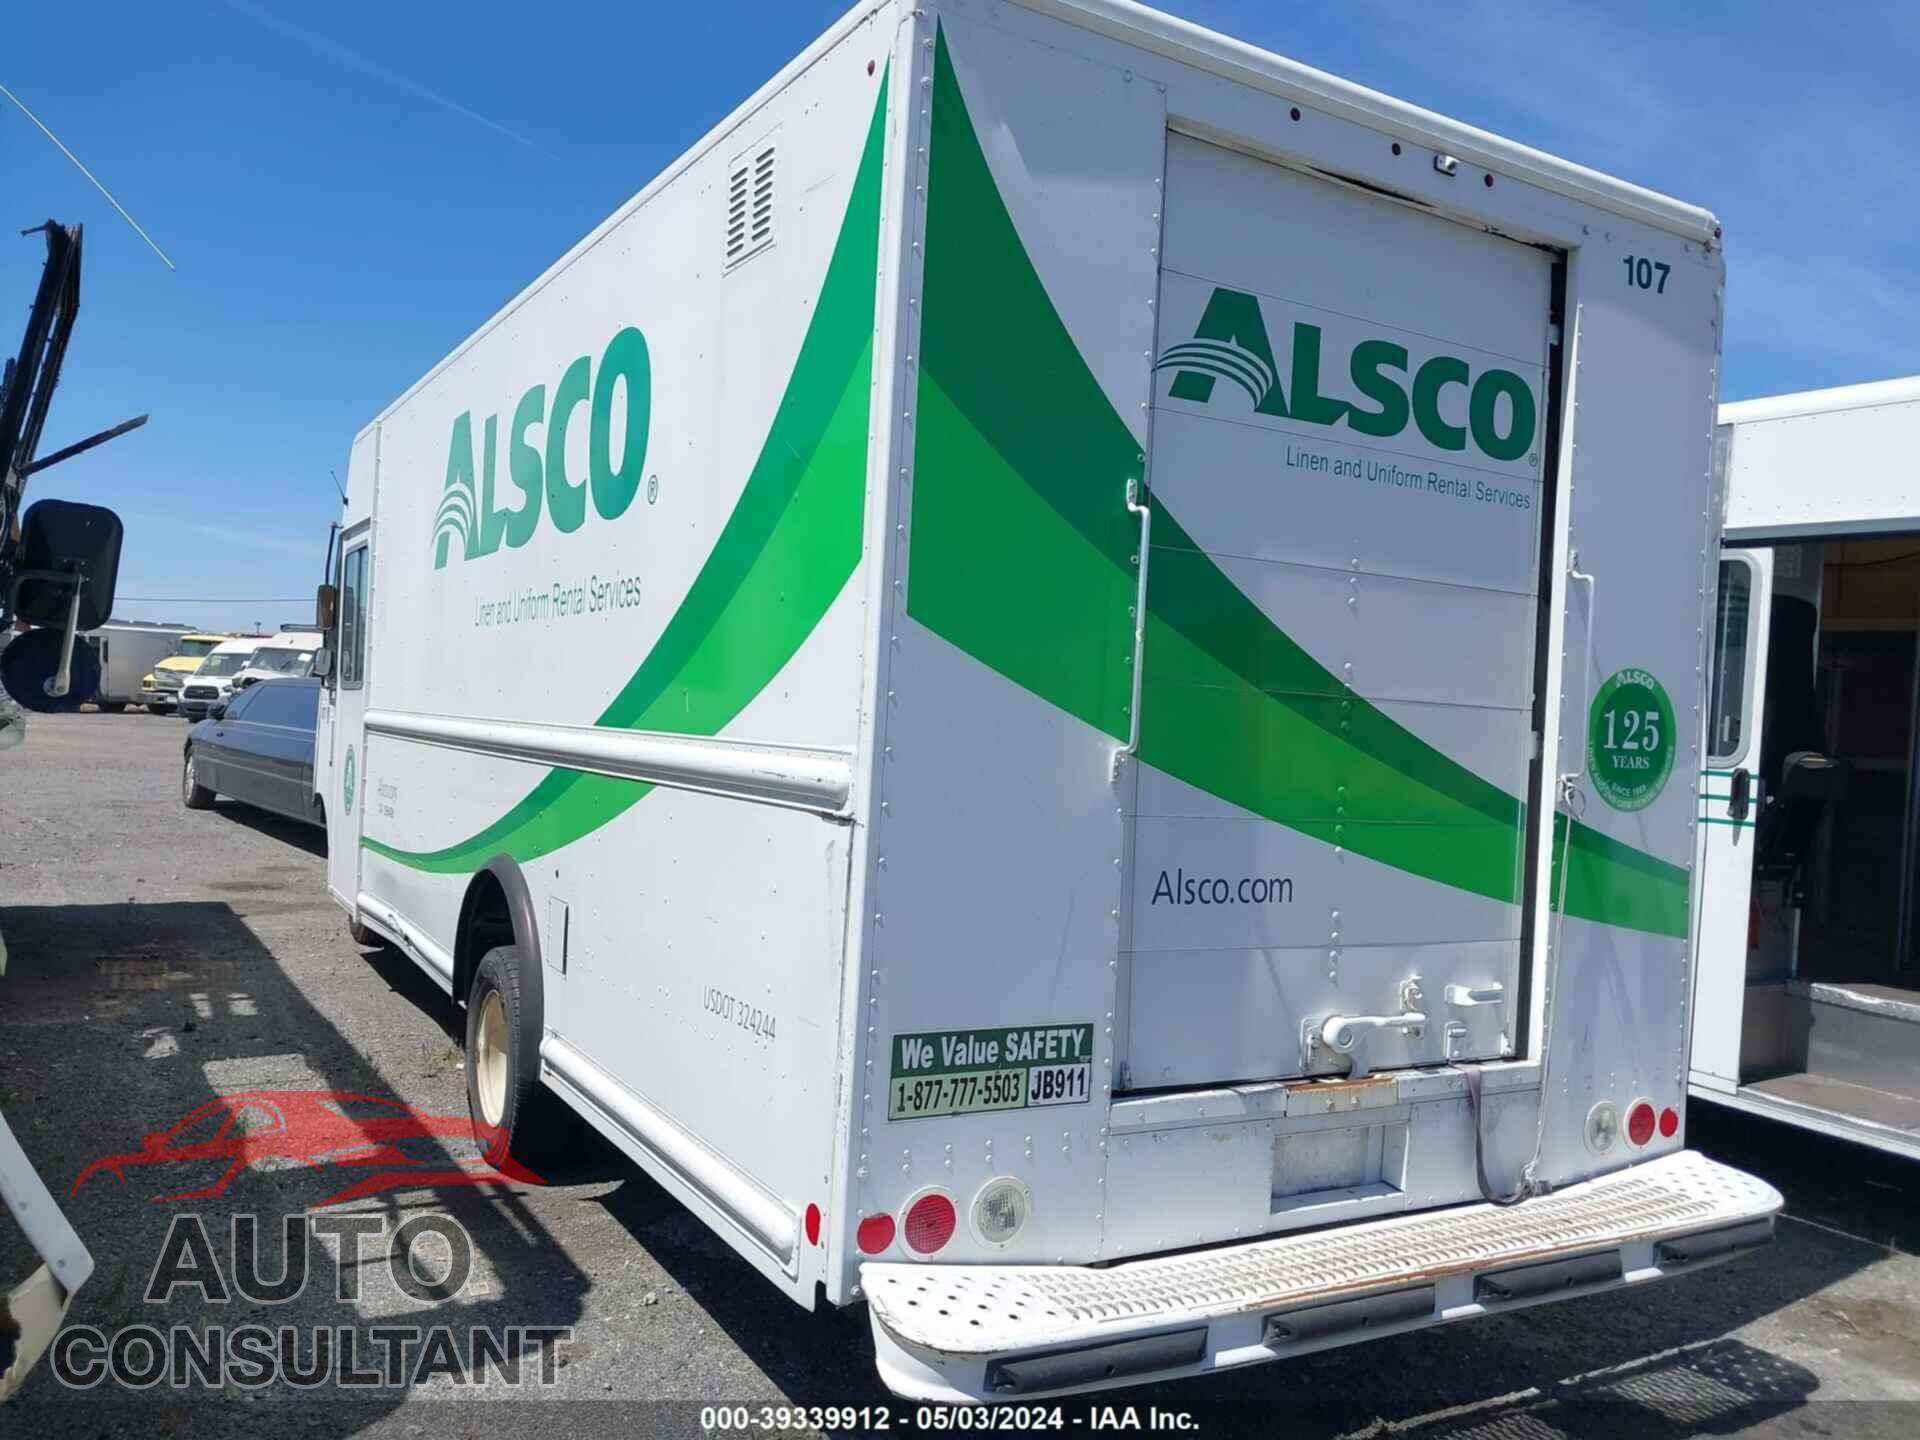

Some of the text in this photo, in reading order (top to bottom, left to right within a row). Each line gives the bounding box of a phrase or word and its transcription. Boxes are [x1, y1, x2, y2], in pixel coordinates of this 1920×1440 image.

[1623, 255, 1671, 294] 107
[1152, 286, 1535, 461] ALSCO
[431, 326, 651, 570] ALSCO
[1286, 445, 1531, 509] Linen and Uniform Rental Services
[475, 573, 641, 627] Linen and Uniform Rental Services
[1615, 671, 1655, 690] ALSCO
[1603, 709, 1660, 752] 125
[1612, 756, 1650, 769] YEARS
[1151, 867, 1293, 905] Alsco.com
[704, 985, 776, 1040] USDOT 324244
[902, 1028, 1086, 1070] We Value SAFETY
[897, 1067, 1085, 1112] 1-877-777-5503 JB911
